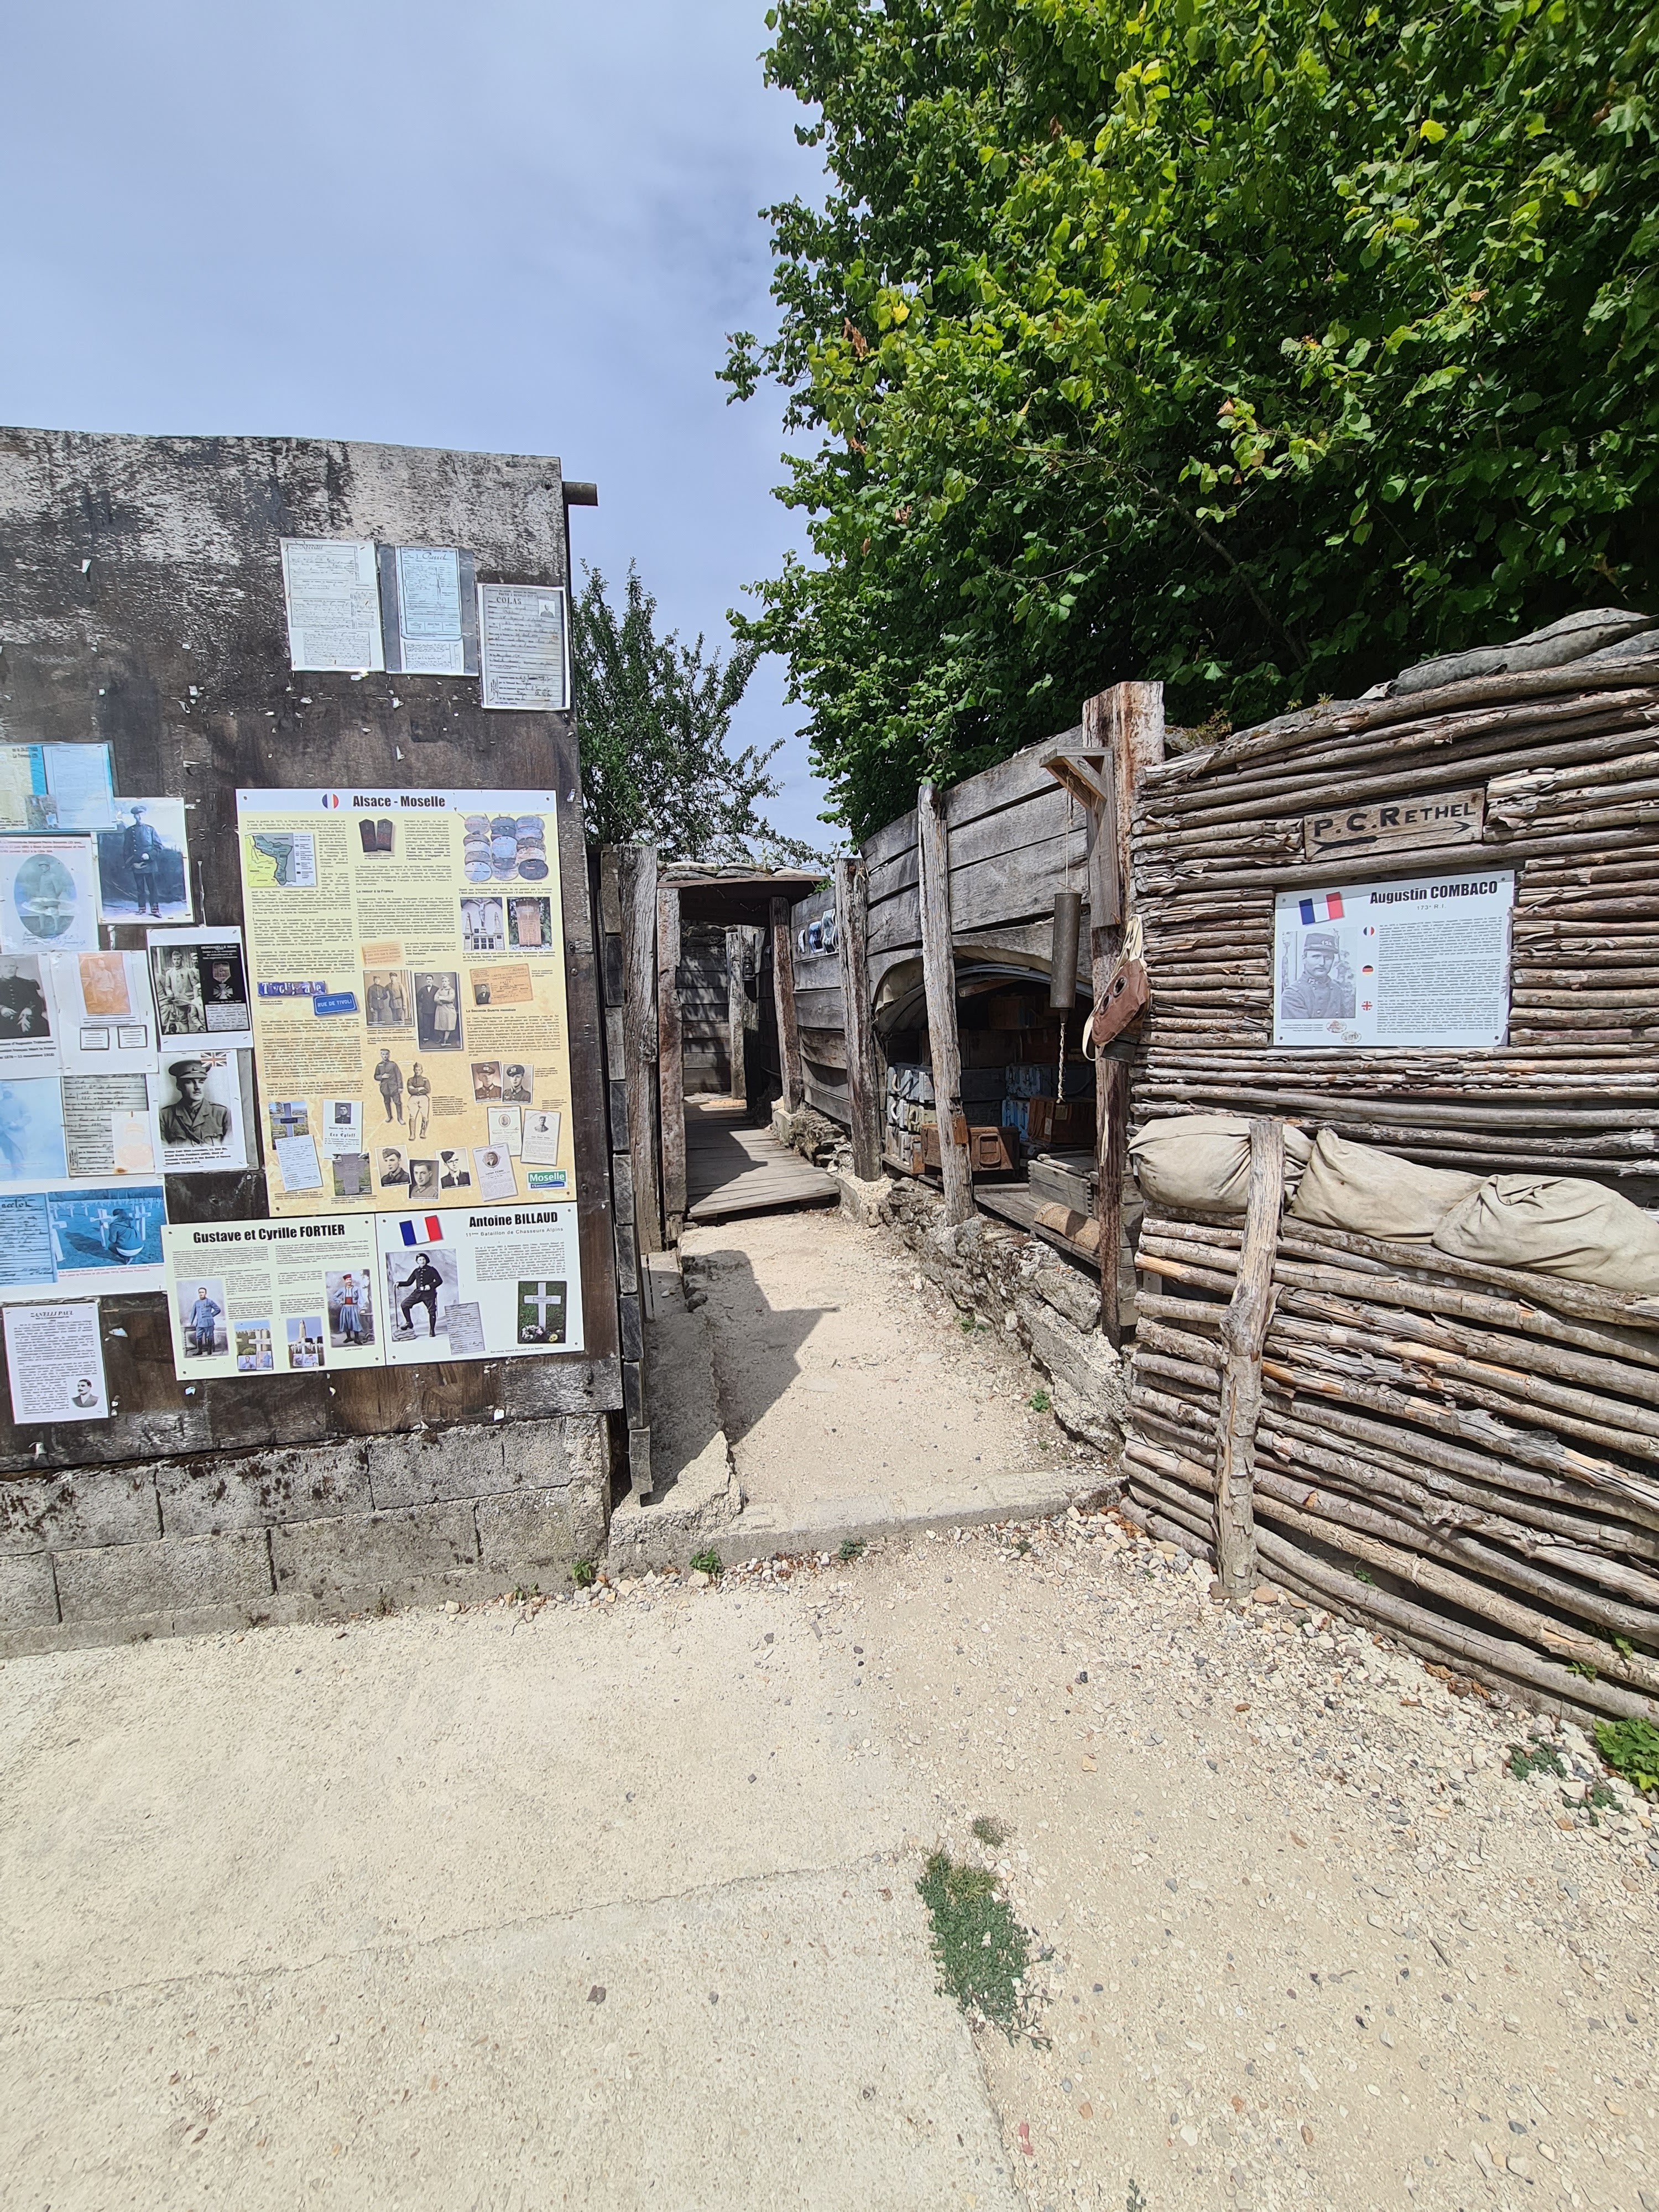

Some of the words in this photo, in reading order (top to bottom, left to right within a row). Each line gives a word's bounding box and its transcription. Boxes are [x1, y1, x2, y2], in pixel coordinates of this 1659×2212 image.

[497, 596, 522, 605] COLAS
[353, 795, 391, 807] Alsace
[400, 795, 445, 807] Moselle
[1380, 802, 1476, 827] RETHEL
[1370, 889, 1427, 904] Augustin
[1431, 881, 1498, 899] COMBACO
[530, 1172, 565, 1182] Moselle
[469, 1215, 512, 1227] Antoine
[515, 1212, 557, 1224] BILLAUD
[194, 1231, 242, 1243] Gustave
[244, 1229, 257, 1240] et
[259, 1227, 297, 1240] Cyrille
[300, 1224, 345, 1237] FORTIER
